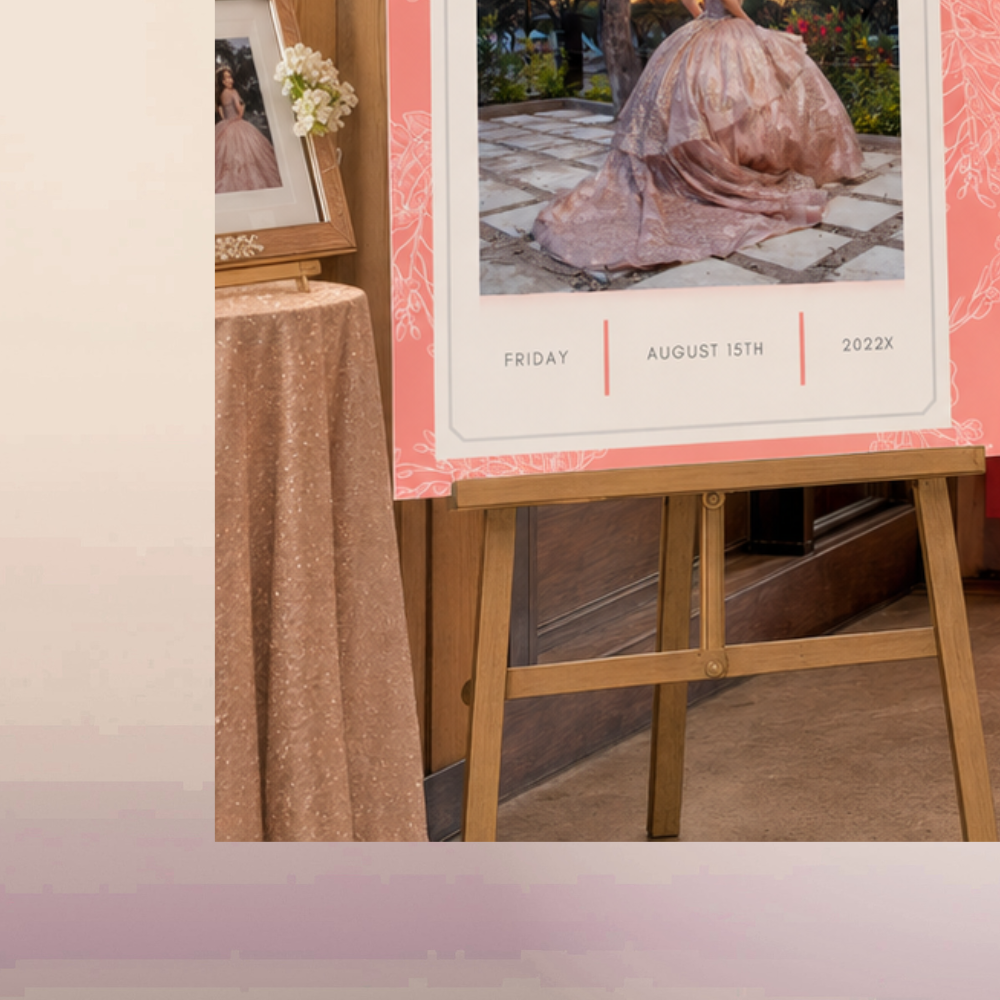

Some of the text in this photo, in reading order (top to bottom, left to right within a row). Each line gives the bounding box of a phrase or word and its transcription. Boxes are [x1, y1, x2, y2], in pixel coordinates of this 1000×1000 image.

[647, 342, 763, 360] AUGUST 15TH
[842, 337, 893, 351] 2022X
[505, 351, 568, 366] FRIDAY
